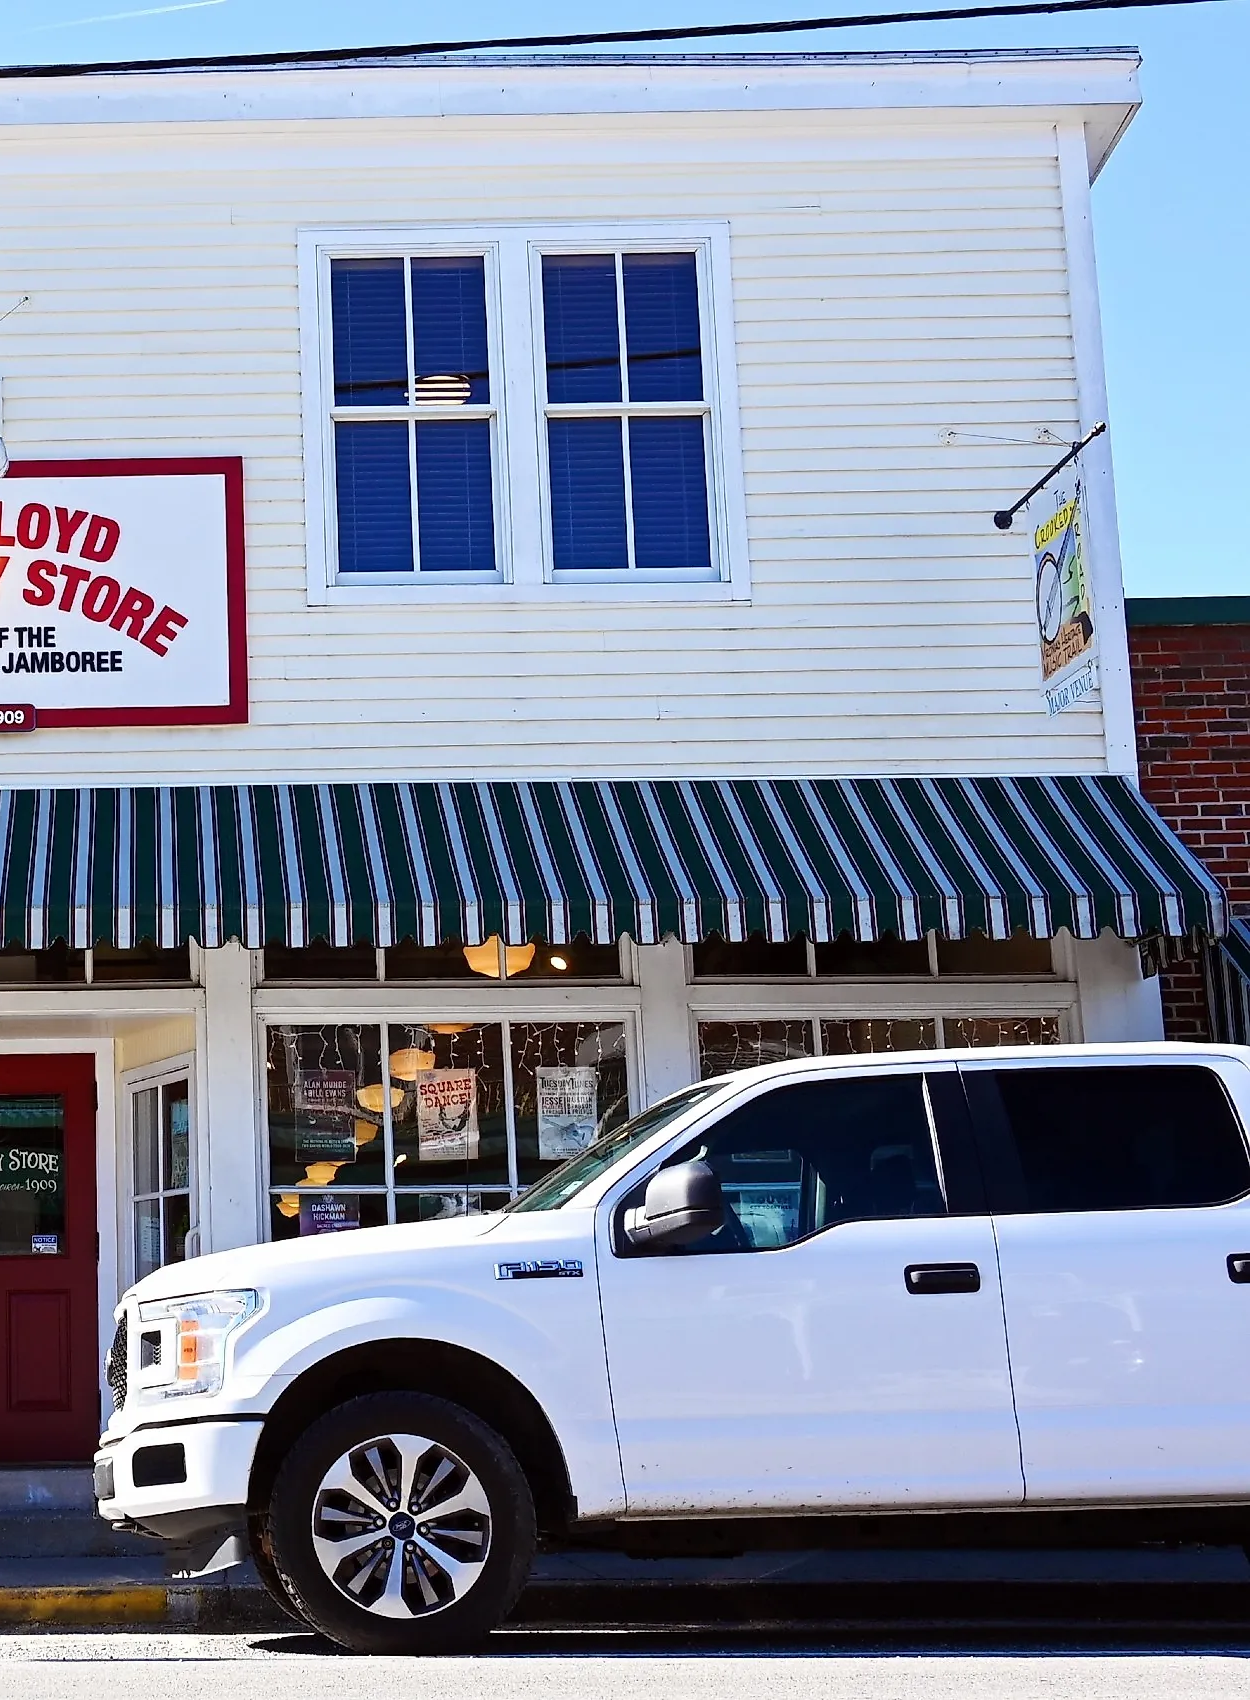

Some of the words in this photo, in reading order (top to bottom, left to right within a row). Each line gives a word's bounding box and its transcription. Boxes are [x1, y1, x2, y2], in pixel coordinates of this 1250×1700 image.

[1034, 507, 1069, 550] CROOKED
[22, 559, 190, 658] STORE
[14, 626, 57, 648] THE
[1063, 638, 1083, 665] TRAIL
[1, 650, 123, 674] JAMBOREE
[1046, 687, 1070, 717] MAJOR
[1070, 671, 1094, 701] VENUE
[303, 1080, 321, 1089] ALAN
[325, 1089, 347, 1098] EVANS
[420, 1078, 471, 1095] SQUARE
[424, 1092, 471, 1108] DANCE!
[541, 1096, 563, 1106] JESSE
[8, 1148, 59, 1174] STORE
[311, 1203, 346, 1212] DASHAWN
[313, 1212, 345, 1221] HICKMAN
